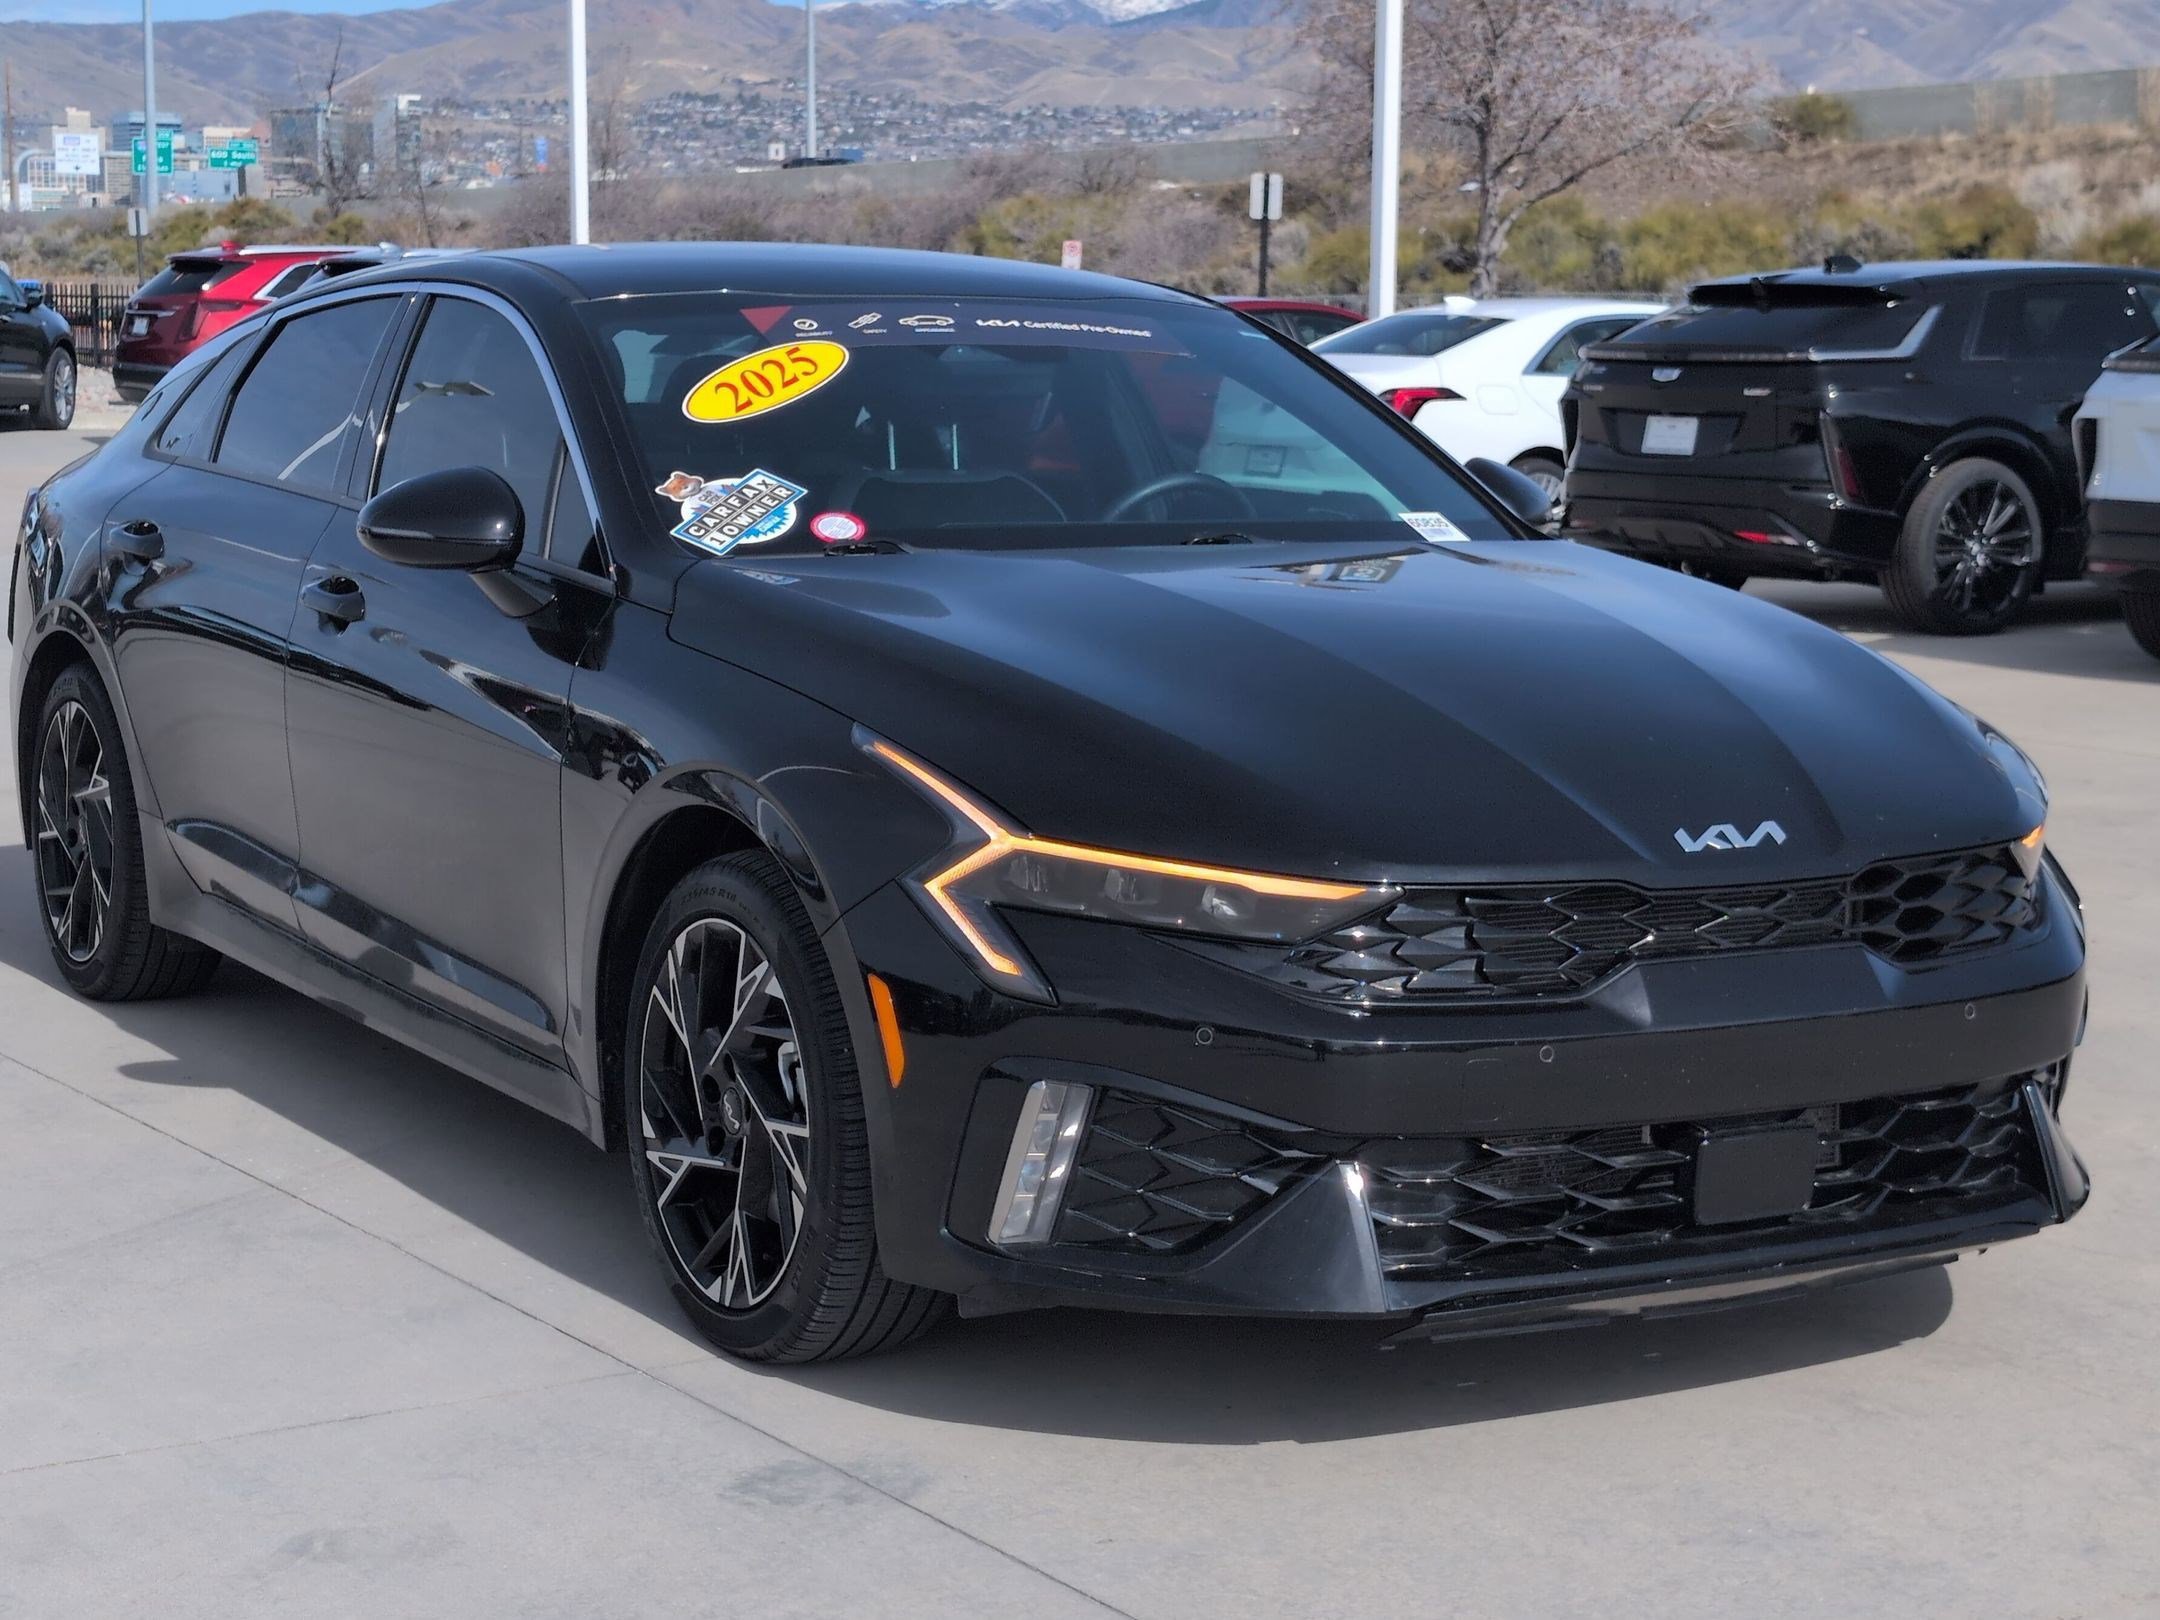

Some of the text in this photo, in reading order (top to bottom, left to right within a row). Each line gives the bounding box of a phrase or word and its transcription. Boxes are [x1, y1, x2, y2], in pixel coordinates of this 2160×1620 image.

[1023, 320, 1080, 331] Certified
[1080, 323, 1152, 338] Pre-Owned
[714, 346, 818, 414] 2025
[688, 479, 775, 538] CARFAX
[1673, 820, 1787, 853] KIA
